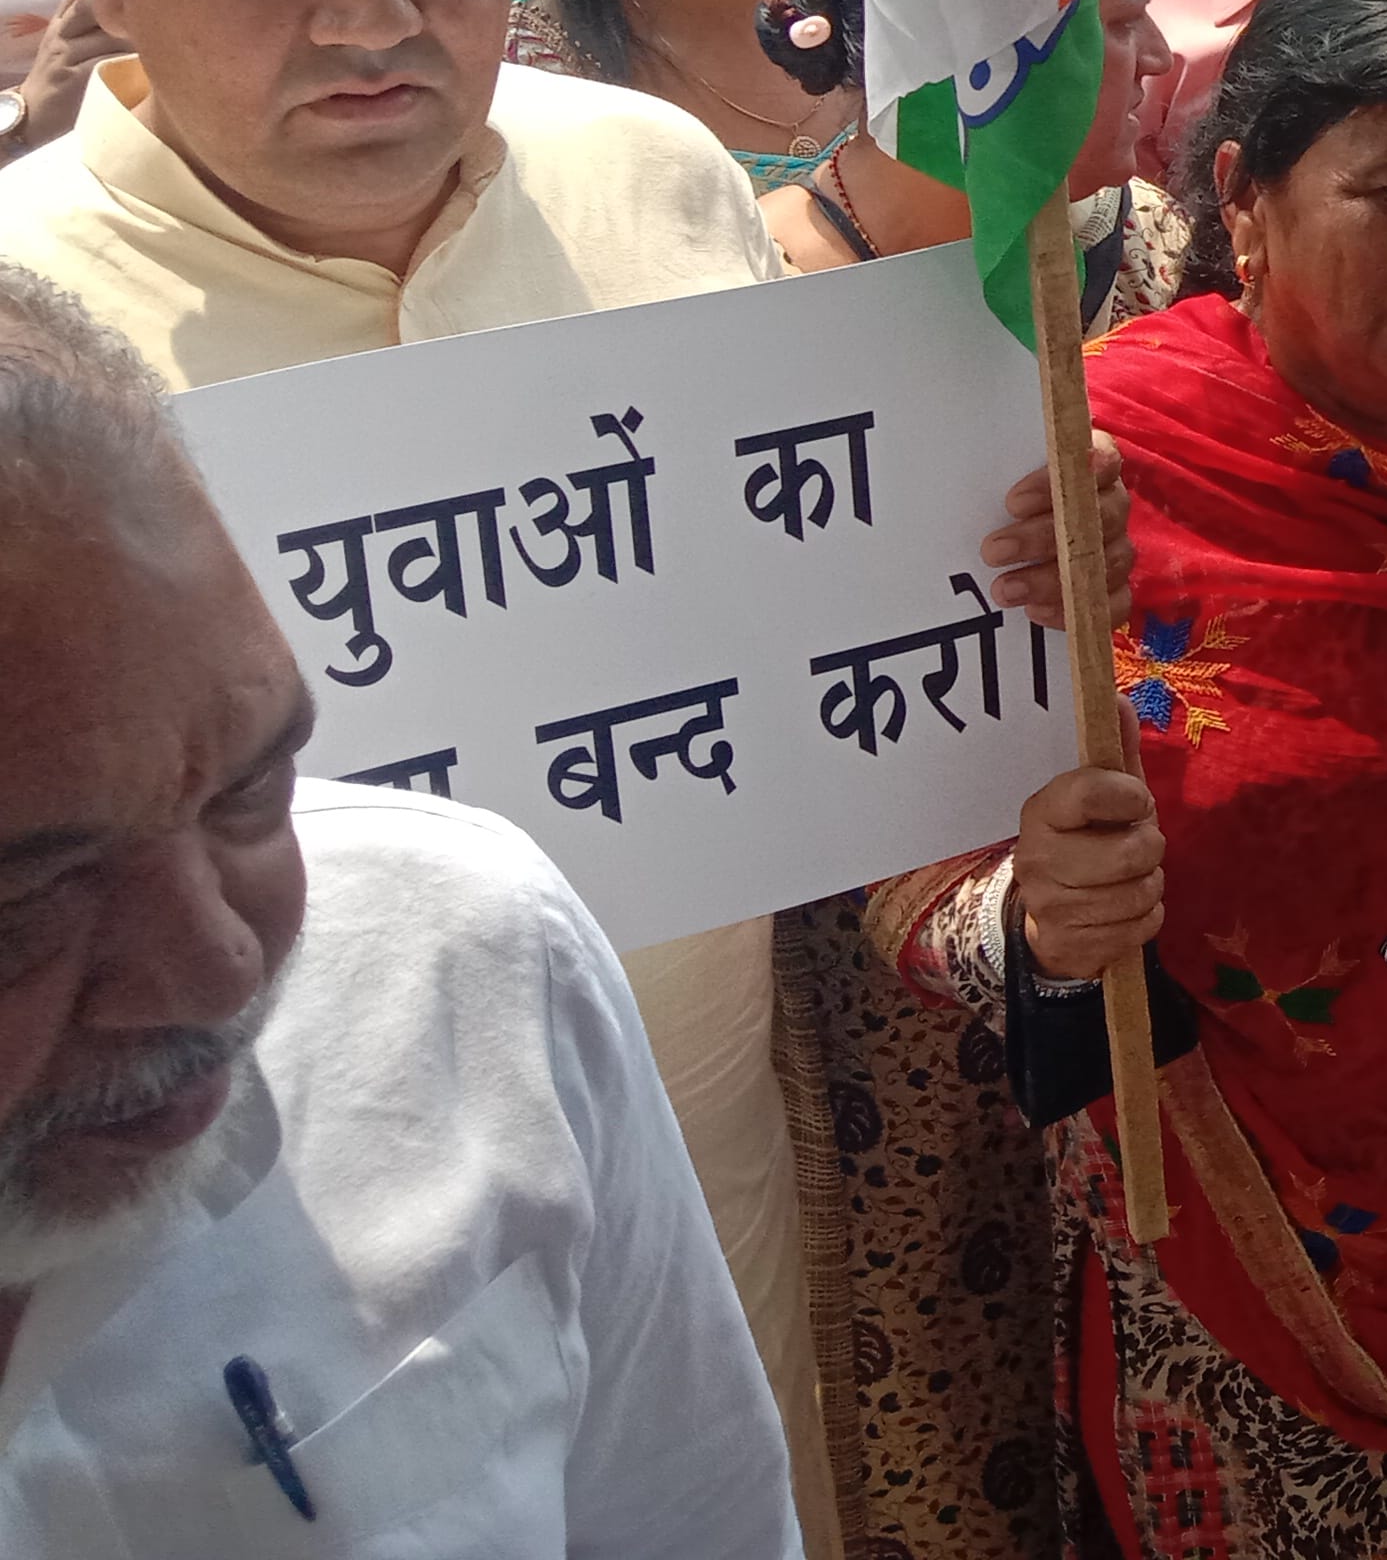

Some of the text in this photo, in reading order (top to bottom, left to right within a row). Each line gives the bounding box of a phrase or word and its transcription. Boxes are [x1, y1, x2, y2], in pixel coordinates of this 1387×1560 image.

[278, 406, 875, 688] युवाओं का
[535, 677, 739, 824] बन्द
